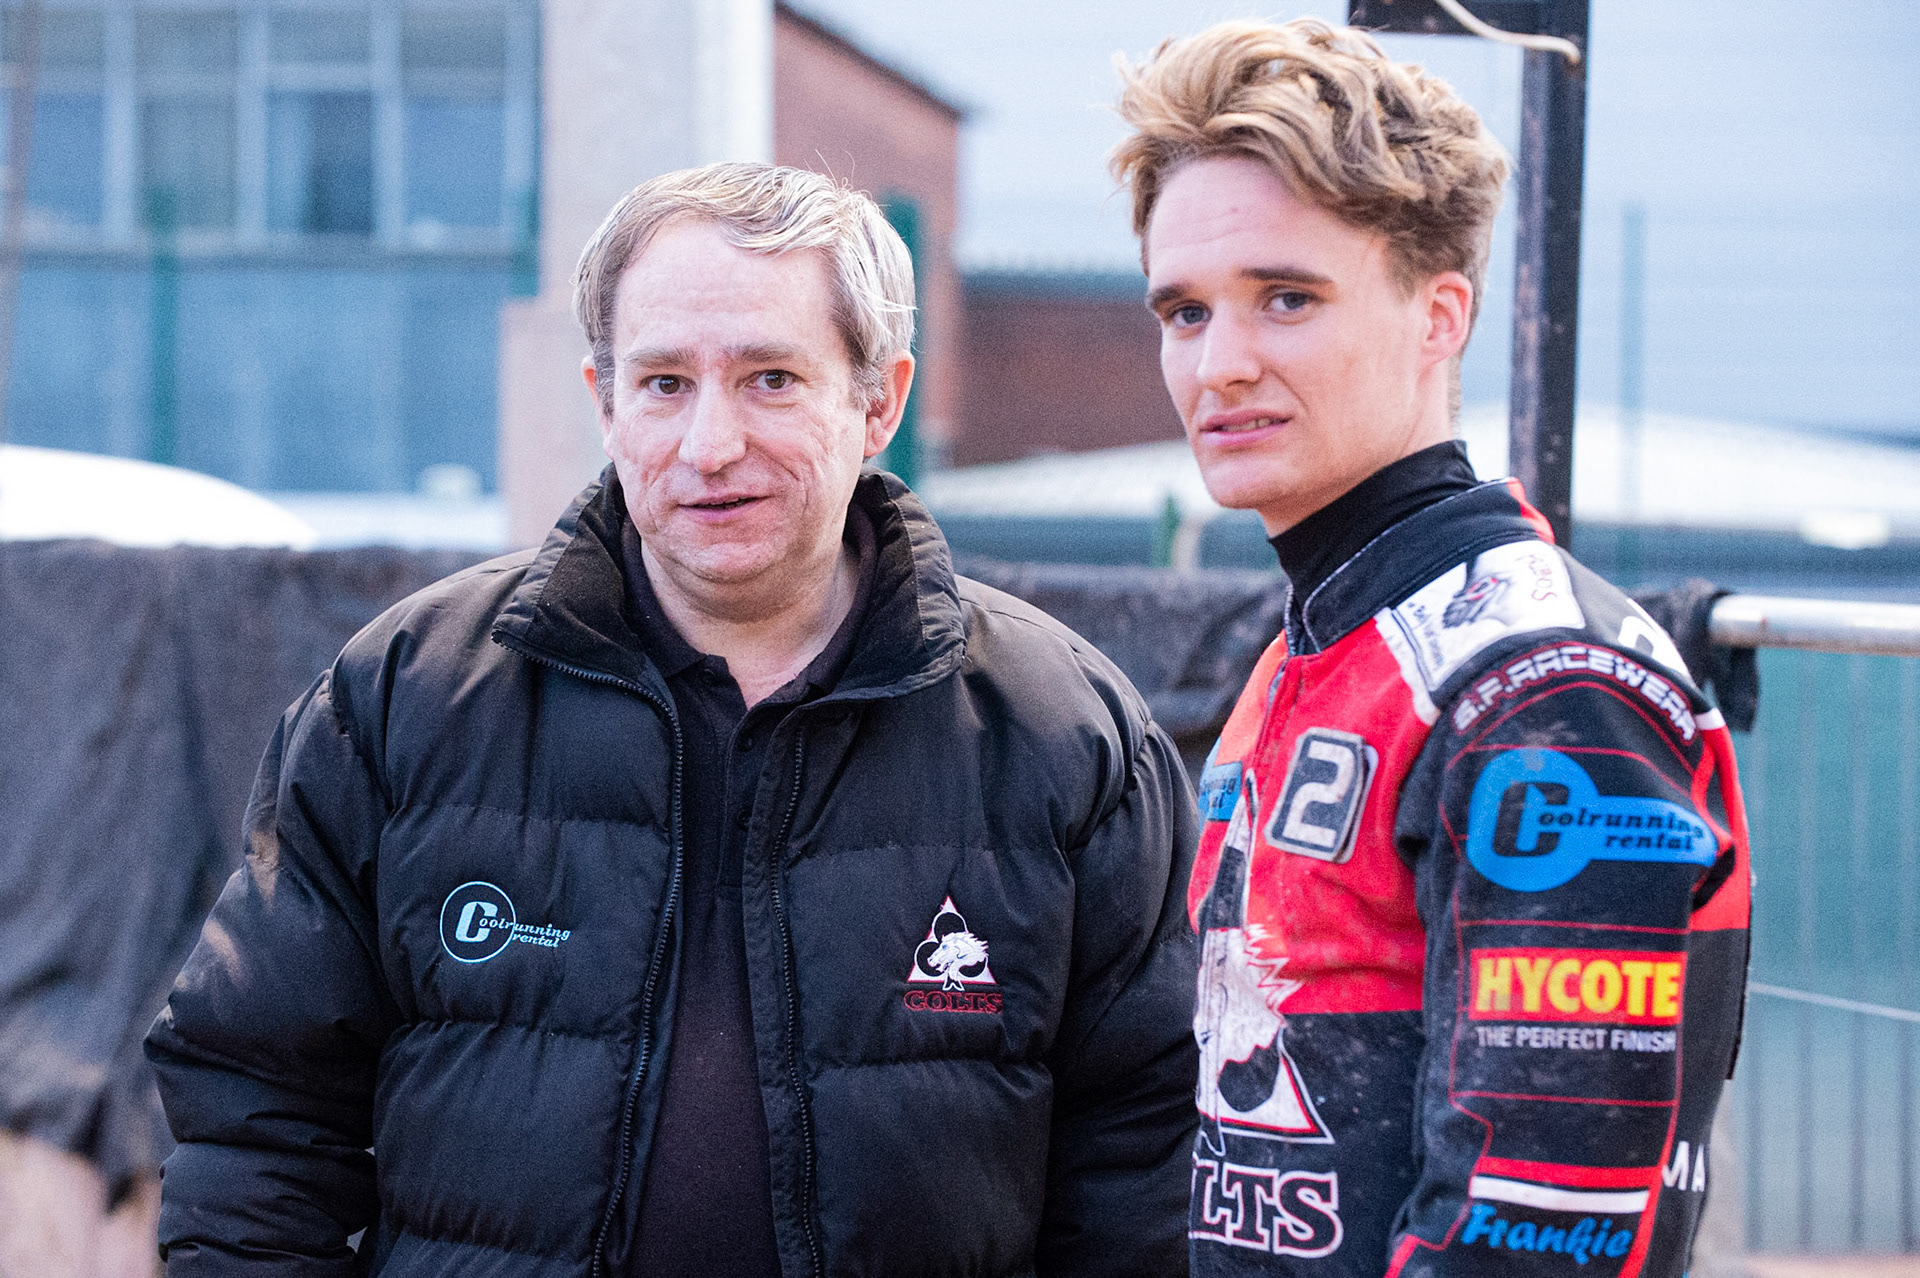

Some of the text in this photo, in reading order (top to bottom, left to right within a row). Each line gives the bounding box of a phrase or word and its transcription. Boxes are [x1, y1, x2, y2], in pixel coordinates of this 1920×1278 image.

[1281, 740, 1355, 848] 2
[1493, 782, 1704, 857] Coolrunning
[1606, 833, 1694, 851] rental
[455, 901, 571, 942] Coolrunning
[512, 931, 559, 948] rental
[903, 990, 1004, 1014] COLTS
[1475, 956, 1681, 1017] HYCOTE
[1475, 1026, 1676, 1053] THE PERFECT FINISH
[1461, 1204, 1632, 1265] Frankie
